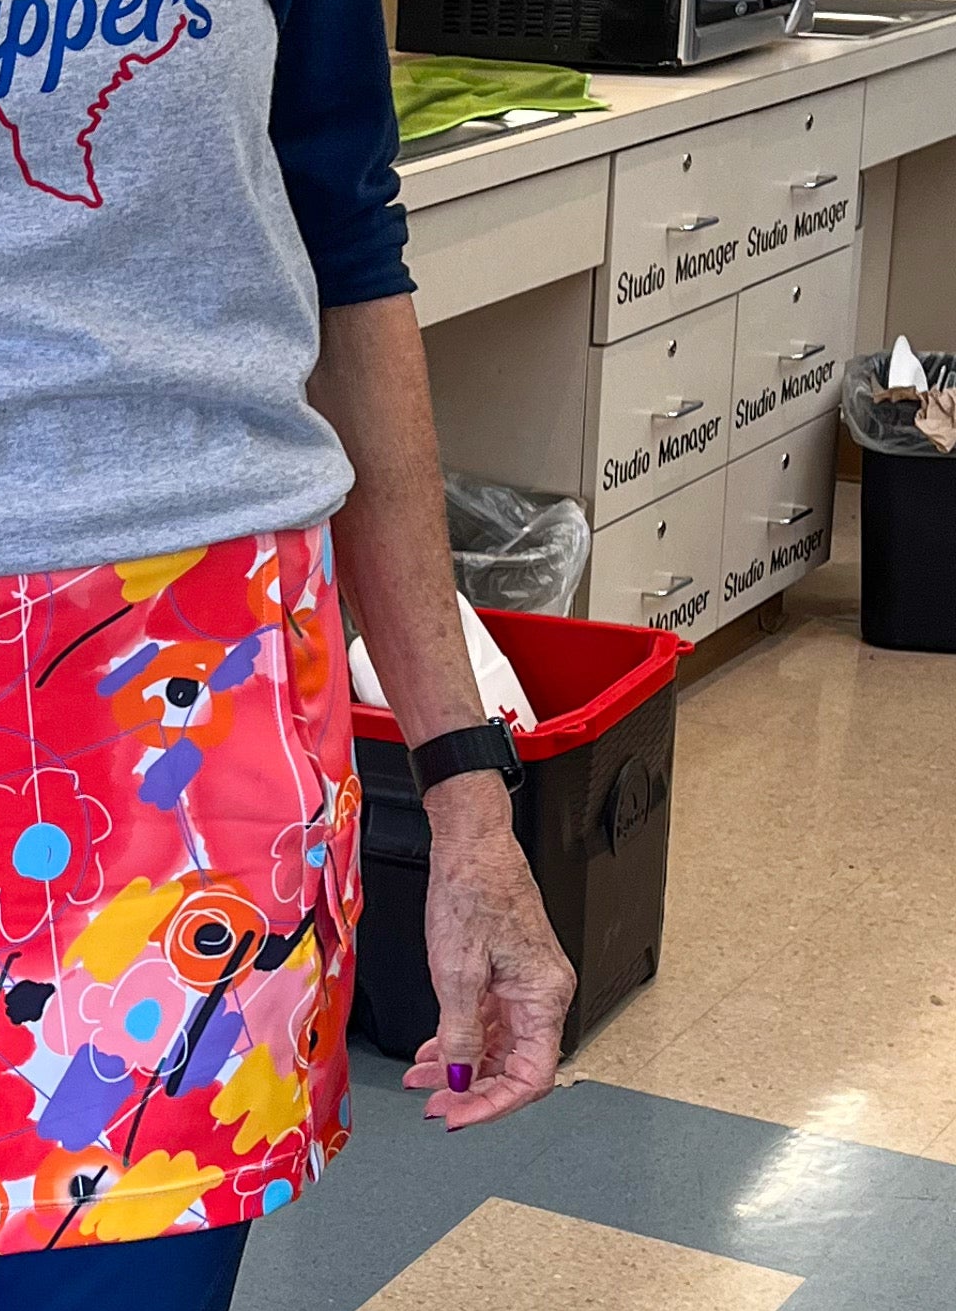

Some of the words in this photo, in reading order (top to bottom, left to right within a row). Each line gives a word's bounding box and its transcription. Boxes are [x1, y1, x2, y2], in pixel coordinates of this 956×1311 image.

[747, 219, 787, 257] Studio
[794, 199, 848, 240] Manager
[617, 263, 665, 304] Studio
[675, 240, 739, 284] Manager
[735, 386, 776, 429] Studio
[781, 360, 835, 405] Manager
[603, 447, 650, 491] Studio
[658, 416, 721, 467] Manager
[724, 558, 765, 602] Studio
[770, 528, 824, 575] Manager
